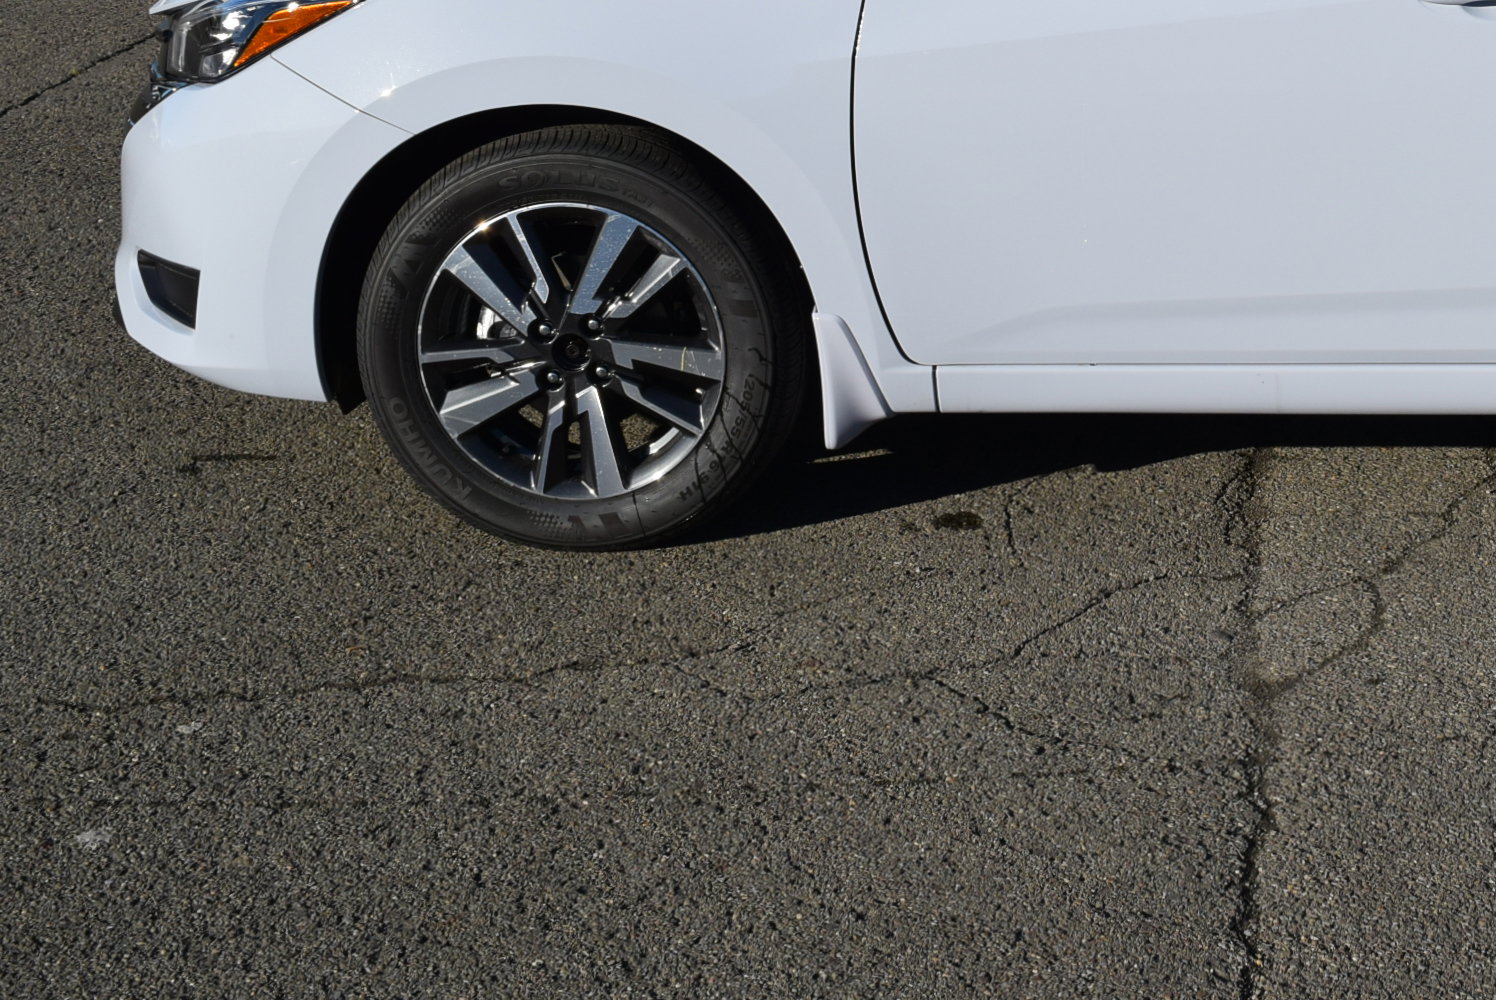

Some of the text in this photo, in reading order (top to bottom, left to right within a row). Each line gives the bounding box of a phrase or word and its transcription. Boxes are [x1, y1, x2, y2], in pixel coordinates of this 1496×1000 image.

[499, 169, 620, 192] SOLUS
[730, 378, 755, 439] 205/55
[389, 396, 472, 501] KUMHO
